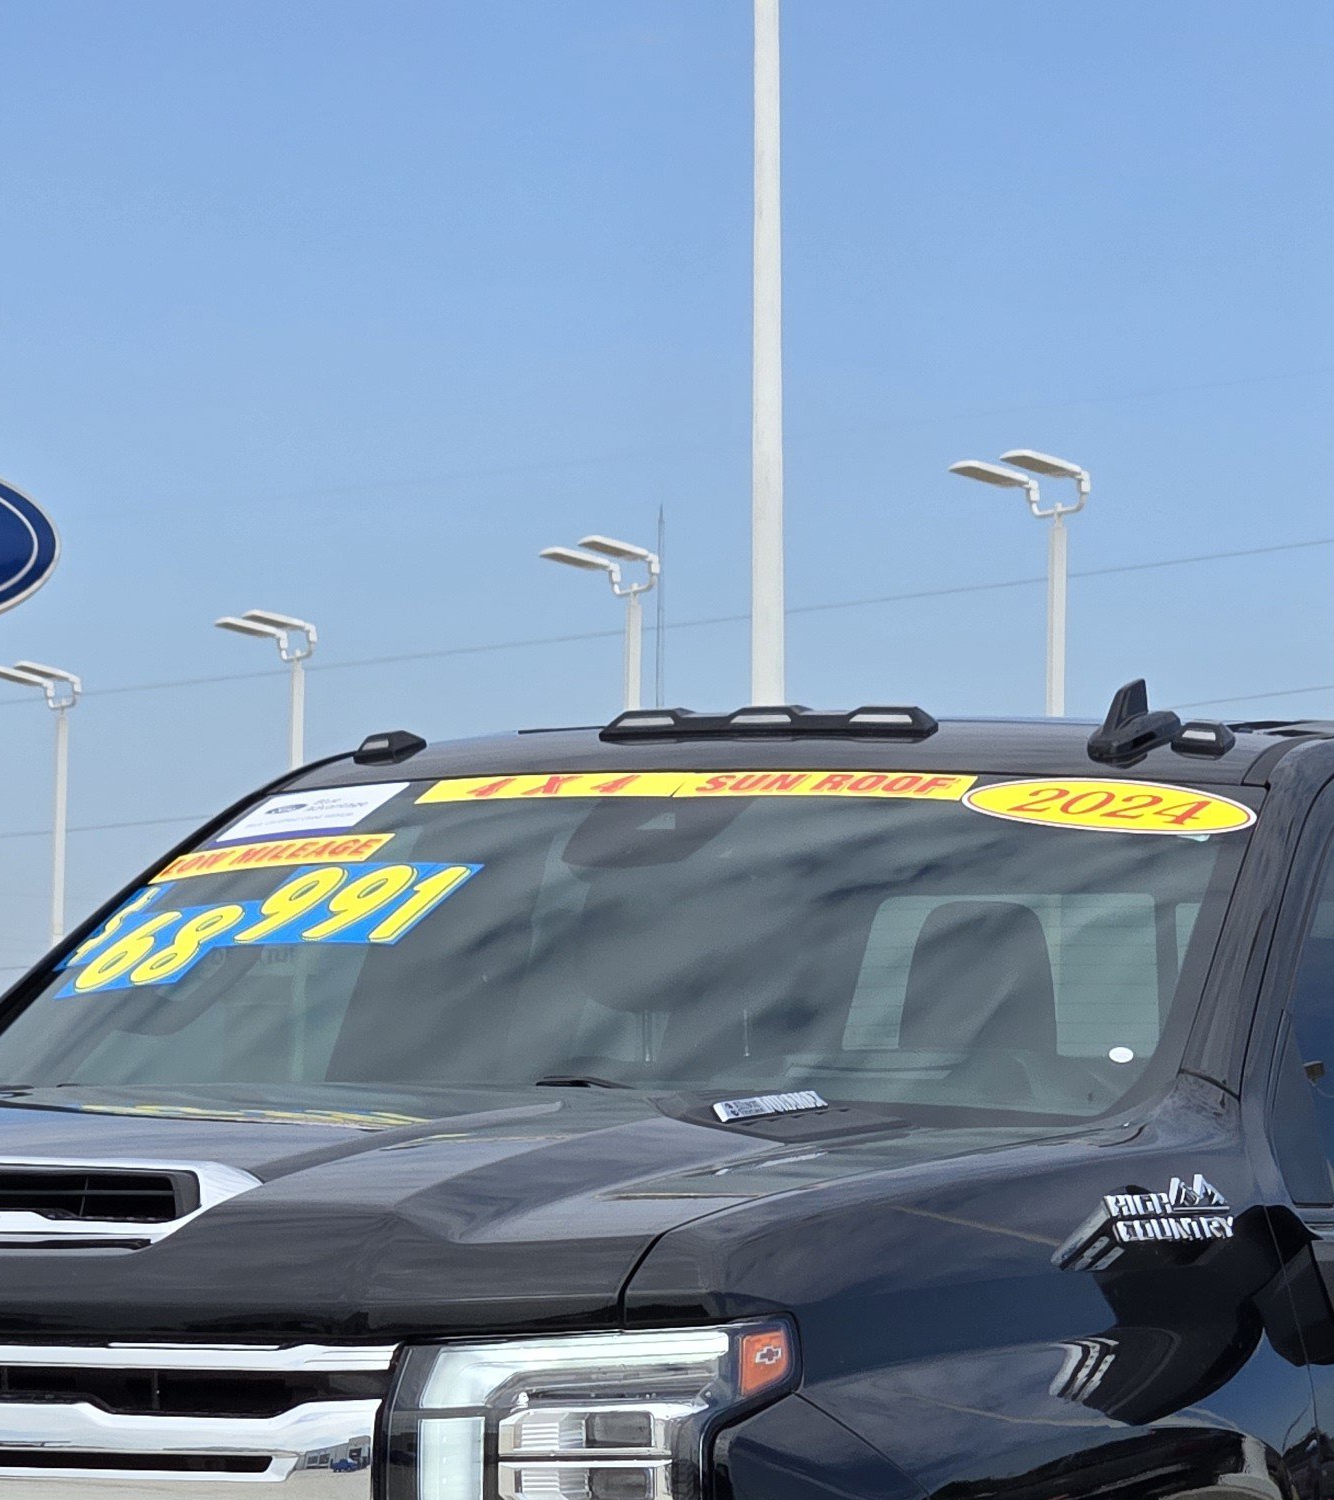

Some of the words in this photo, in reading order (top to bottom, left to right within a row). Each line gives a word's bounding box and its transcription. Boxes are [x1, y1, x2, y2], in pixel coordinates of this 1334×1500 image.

[695, 773, 811, 793] SUN
[810, 773, 961, 796] ROOF
[1006, 787, 1213, 826] 2024
[159, 850, 235, 878] LOW
[229, 838, 384, 866] MILEAGE
[1113, 1215, 1234, 1242] COUNTRY
